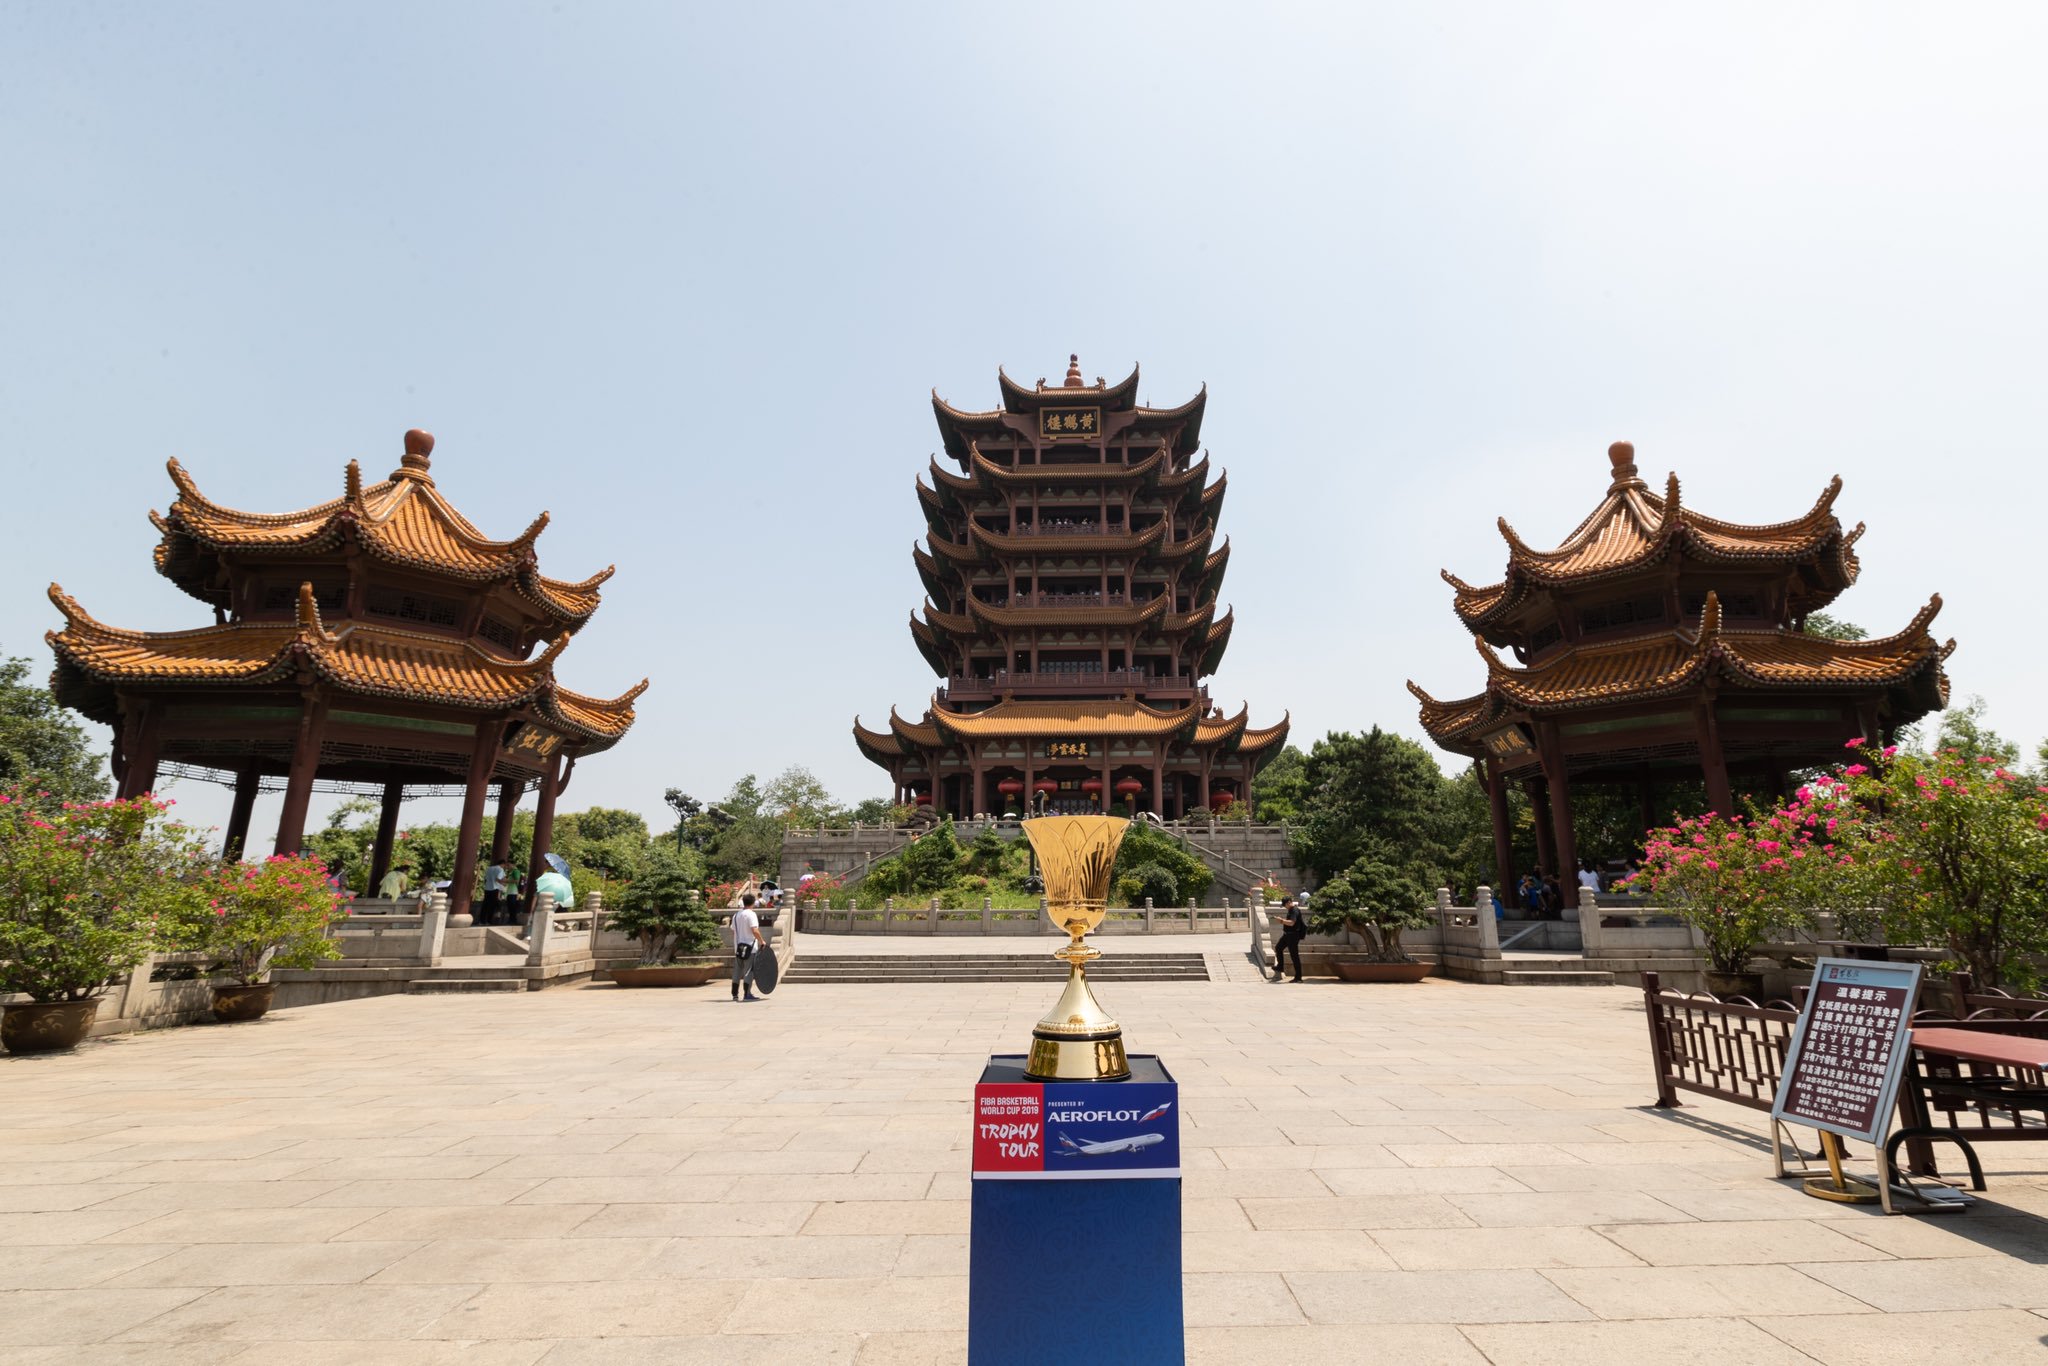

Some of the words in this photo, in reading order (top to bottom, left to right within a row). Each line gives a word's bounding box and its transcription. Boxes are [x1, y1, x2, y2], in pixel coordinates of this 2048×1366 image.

[1837, 987, 1887, 1001] 温馨提示
[980, 1097, 996, 1106] FIBA
[997, 1096, 1040, 1106] BASKETBALL
[980, 1106, 1005, 1115] WORLD
[1006, 1106, 1020, 1115] CUP
[1021, 1106, 1039, 1115] 2019
[1048, 1110, 1141, 1123] AEROFLOT
[979, 1122, 1039, 1140] TROPHY
[998, 1141, 1039, 1158] TOUR
